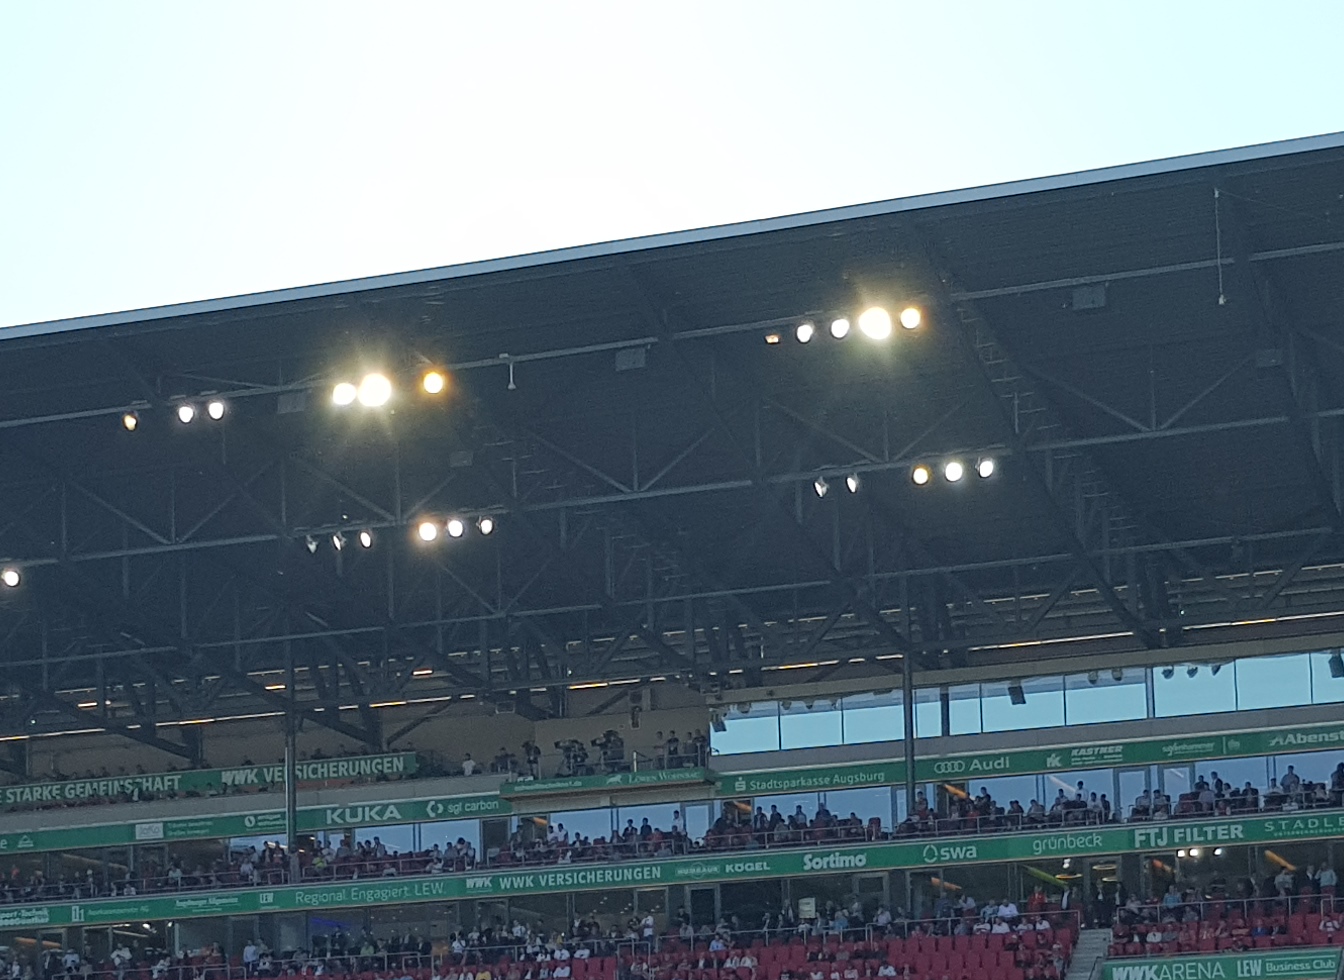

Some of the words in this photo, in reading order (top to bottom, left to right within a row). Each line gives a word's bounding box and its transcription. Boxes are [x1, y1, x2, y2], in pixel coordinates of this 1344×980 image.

[1071, 744, 1123, 756] KASTNER
[220, 768, 258, 786] WWK
[263, 757, 404, 783] VESICHERUNGEN
[969, 756, 1010, 771] Audi
[6, 784, 61, 803] STARKE
[64, 775, 182, 799] GEMEINSHAFT
[750, 775, 830, 791] Stadtsparkasse
[832, 771, 885, 786] Augsburg
[326, 803, 402, 824] KUKA
[447, 802, 462, 815] sgl
[464, 799, 499, 812] carbon
[1033, 833, 1103, 855] grünbeck
[1134, 827, 1168, 848] FTJ
[1173, 824, 1244, 844] FILTER
[803, 851, 867, 871] Sortimo
[940, 845, 977, 861] swa
[725, 861, 771, 873] KÖGEL
[465, 877, 492, 888] WWK
[499, 877, 534, 891] WWK
[538, 866, 661, 887] VERSICHERUNGEN
[259, 893, 273, 903] LEW
[1237, 959, 1262, 978] LEW
[1266, 961, 1311, 973] Business
[1312, 958, 1336, 970] Club
